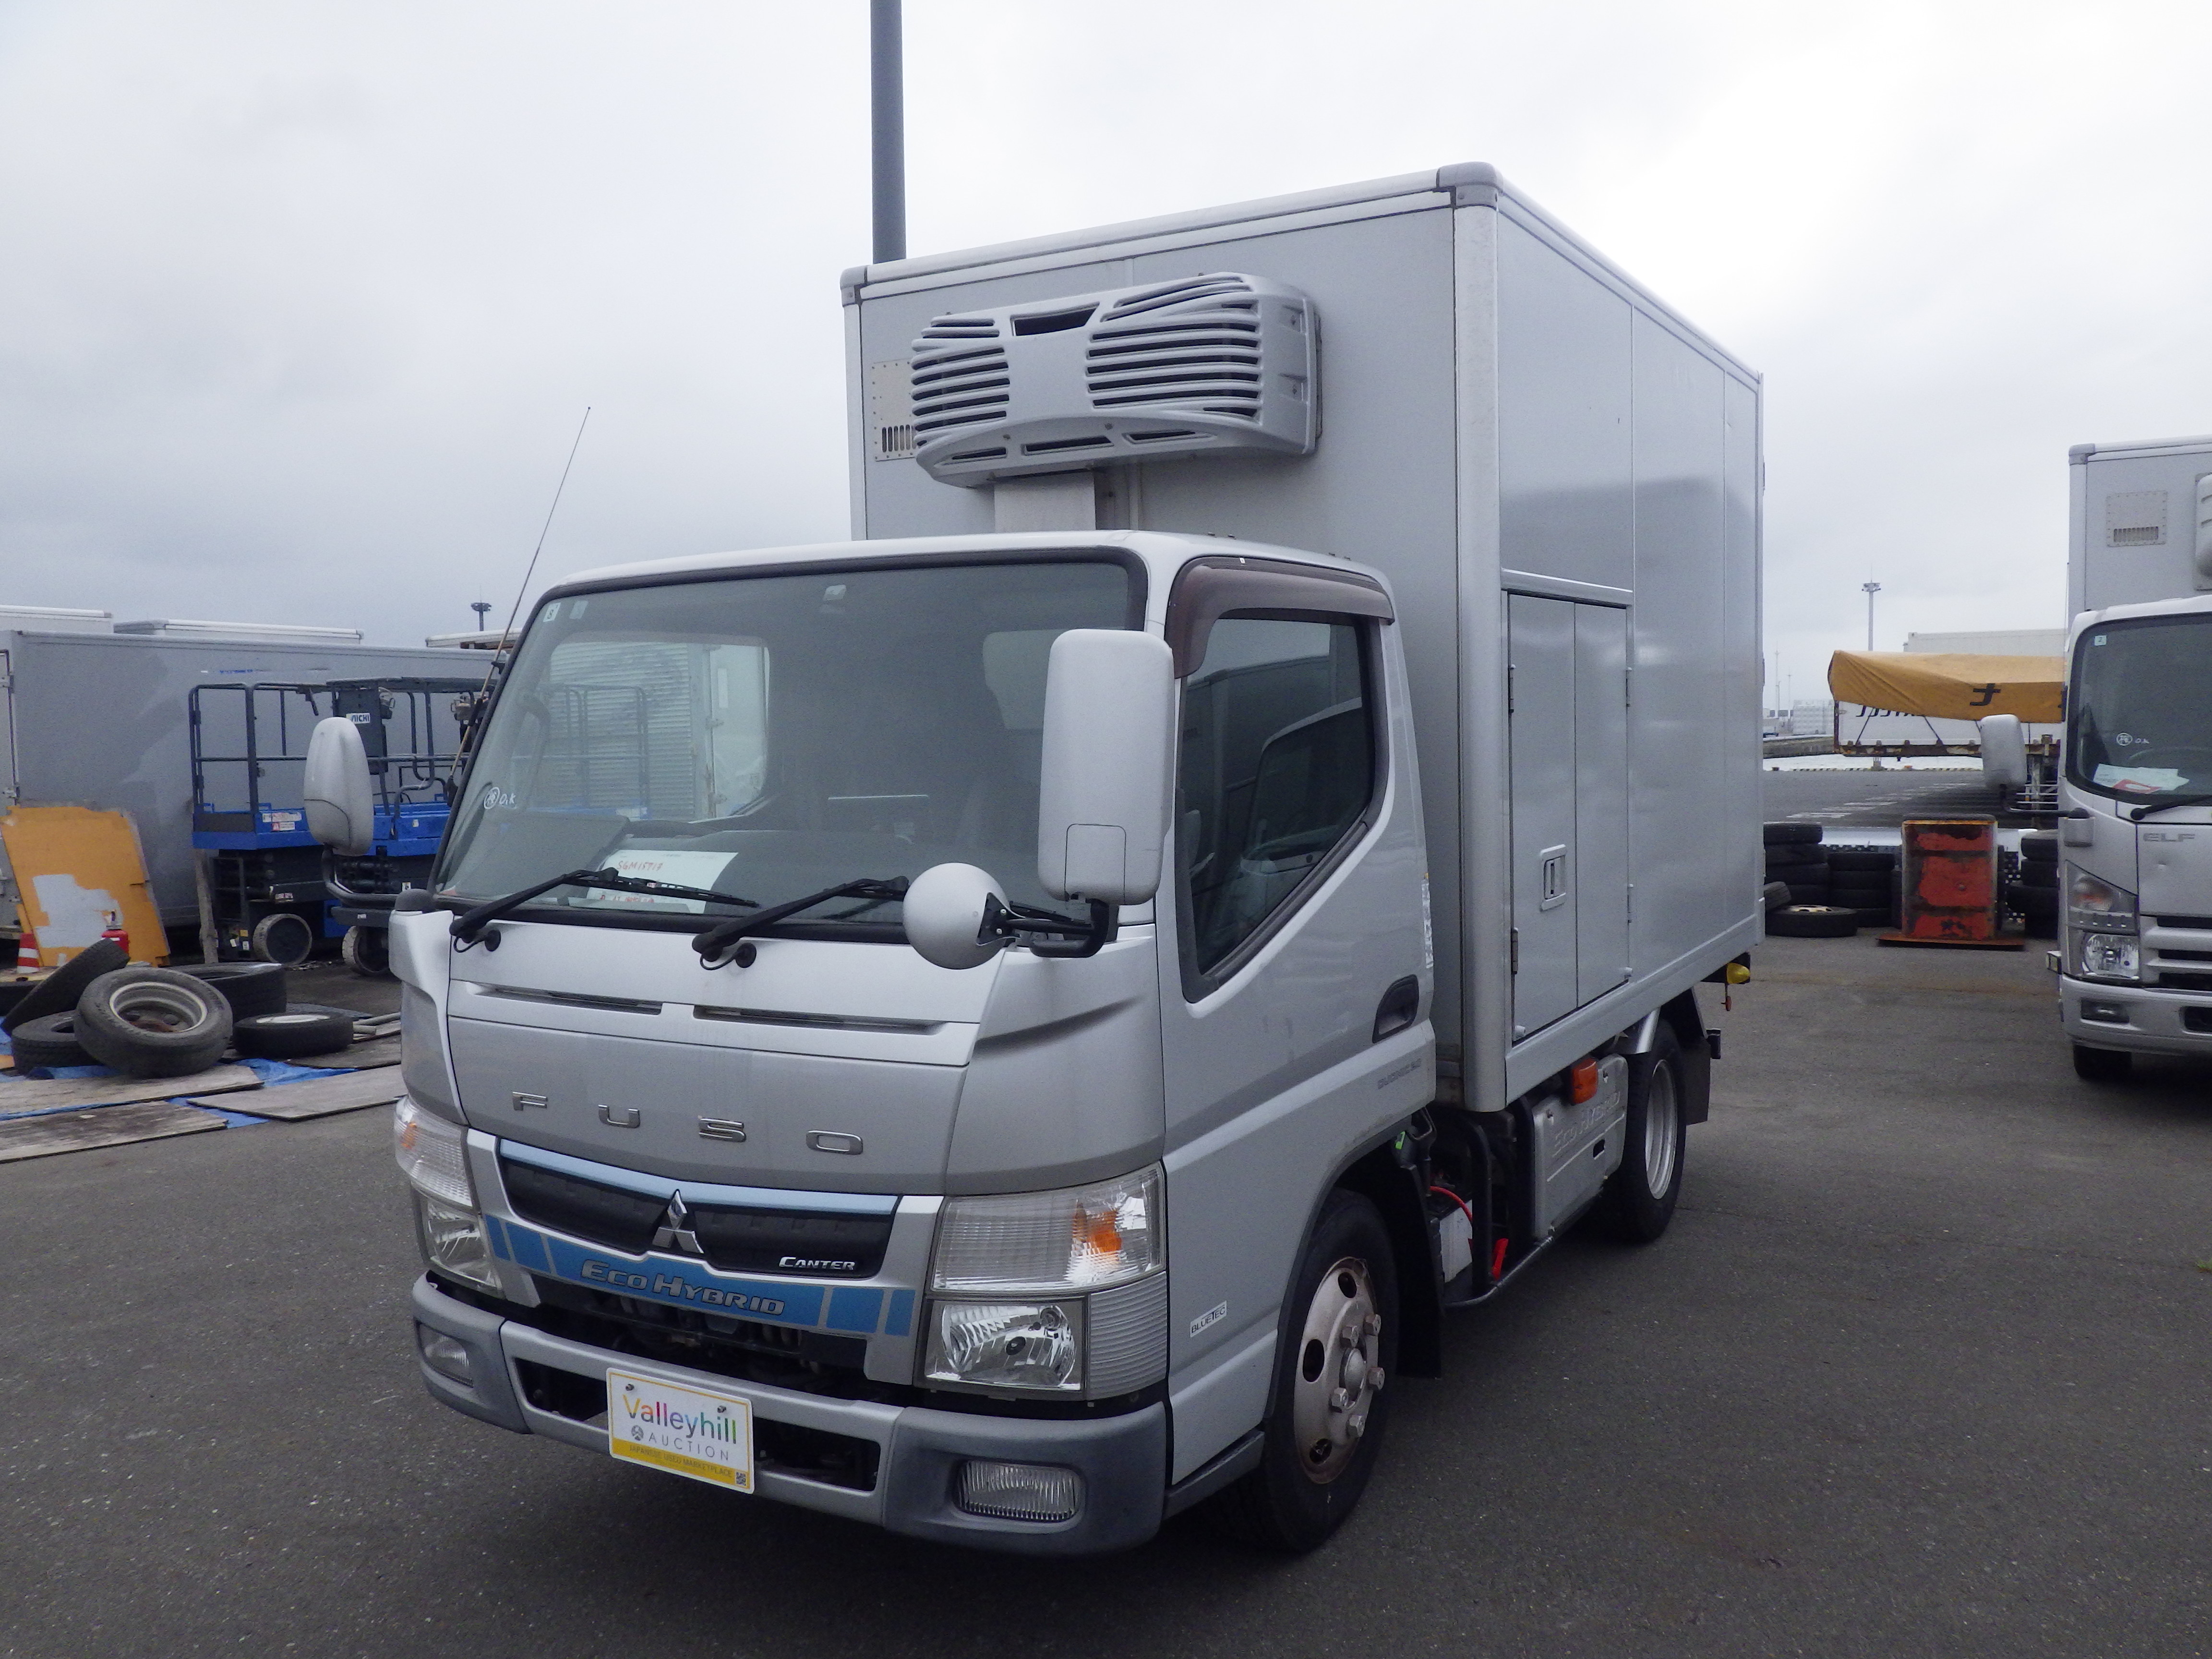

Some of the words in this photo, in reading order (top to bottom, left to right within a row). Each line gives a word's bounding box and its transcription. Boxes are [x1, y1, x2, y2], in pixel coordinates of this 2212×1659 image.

[2143, 833, 2195, 842] ELF
[513, 1091, 863, 1155] FUSO
[779, 1256, 855, 1270] CANTER
[652, 1274, 785, 1315] HYBRID
[623, 1394, 736, 1444] Valleyhill
[649, 1432, 728, 1460] AUCTION
